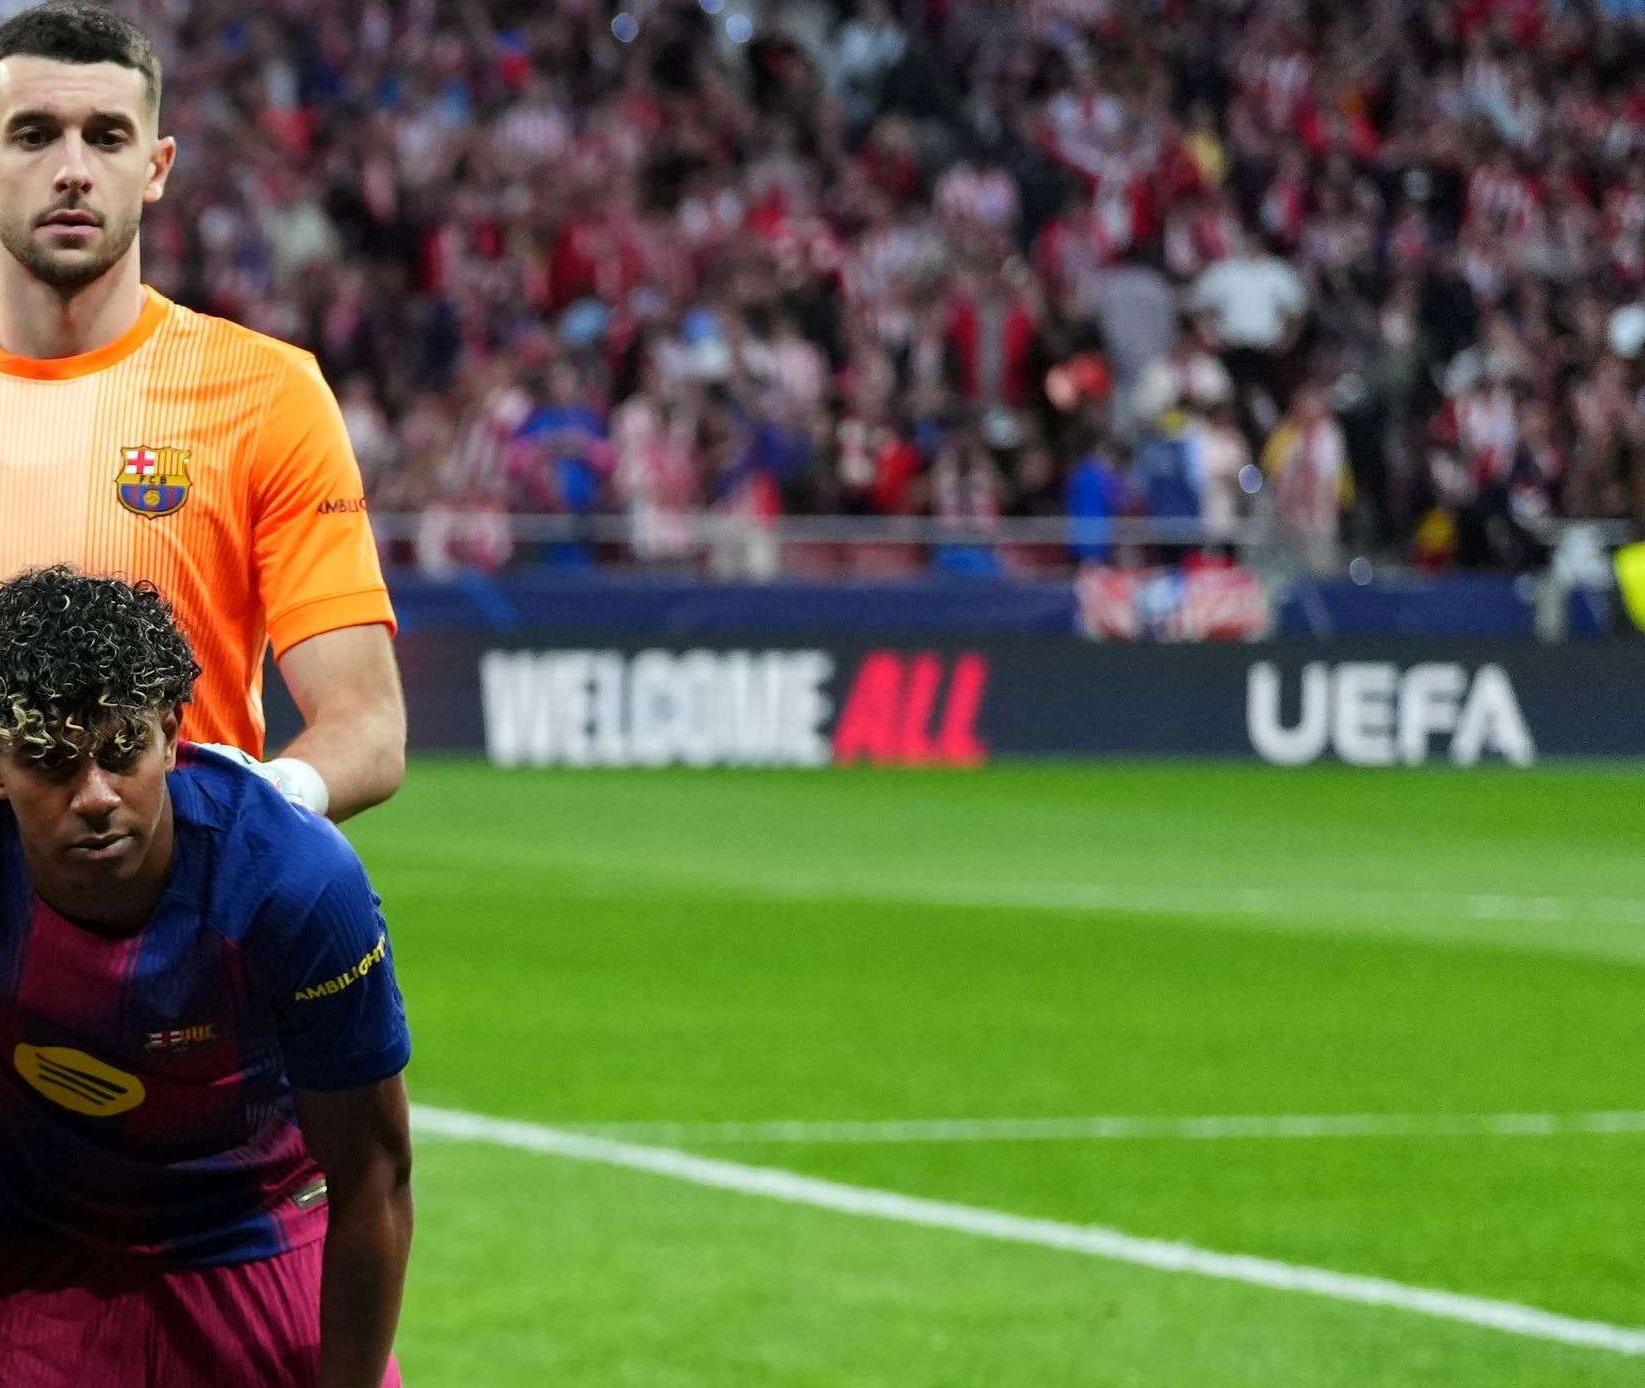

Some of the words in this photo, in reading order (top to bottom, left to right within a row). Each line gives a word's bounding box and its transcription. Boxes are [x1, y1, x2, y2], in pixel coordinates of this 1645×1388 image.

[139, 474, 167, 485] FCB
[479, 648, 837, 768] WELCOME
[829, 650, 988, 768] ALL
[1245, 660, 1537, 768] UEFA
